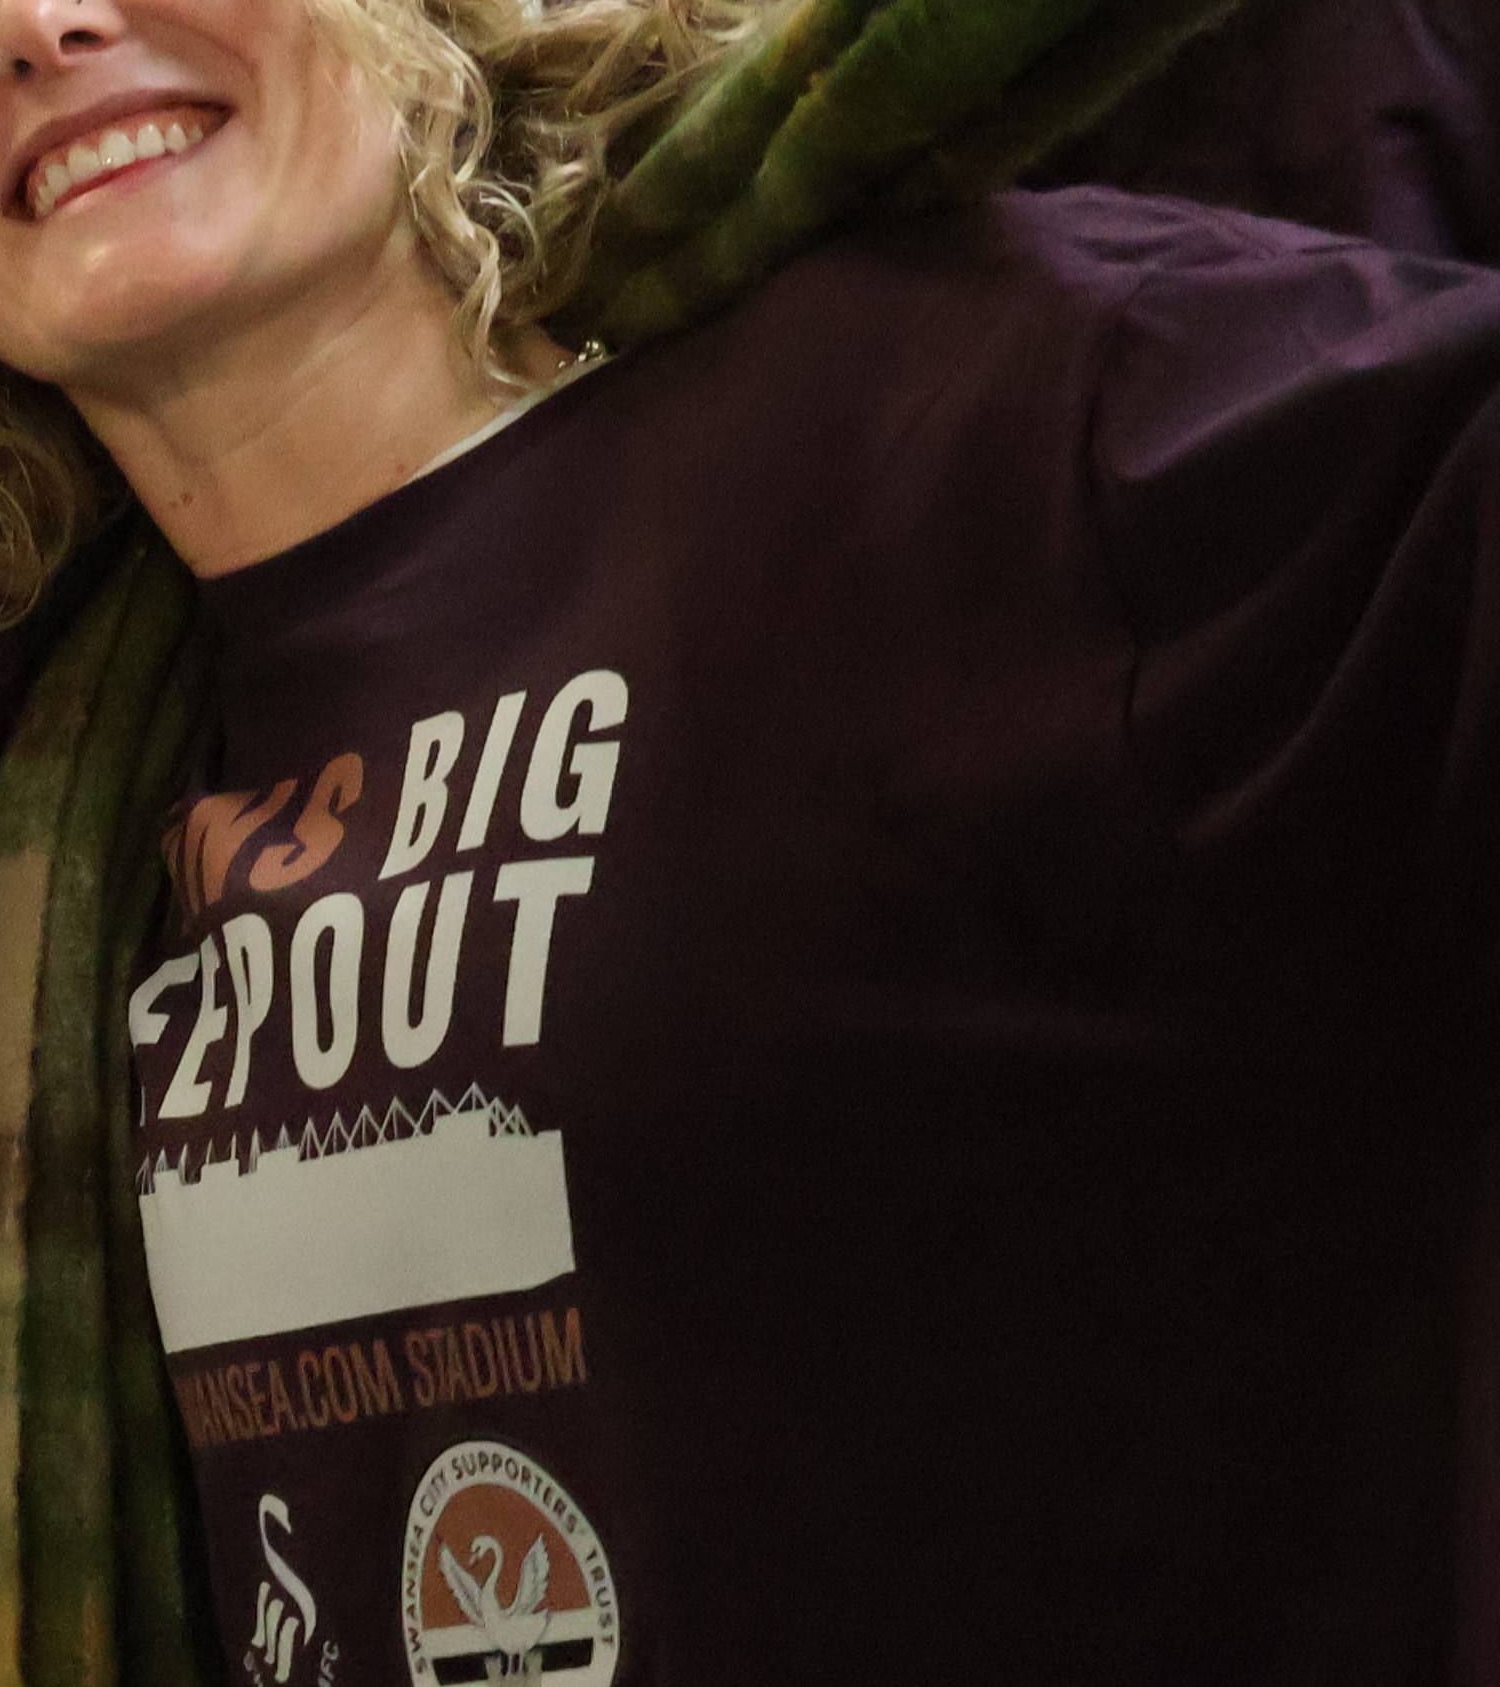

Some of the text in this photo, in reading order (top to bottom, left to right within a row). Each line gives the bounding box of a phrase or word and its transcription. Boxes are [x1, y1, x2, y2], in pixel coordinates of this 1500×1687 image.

[378, 669, 628, 880] BIG
[404, 1307, 588, 1408] STADIUM
[404, 1525, 427, 1677] SWANSEA
[586, 1548, 614, 1645] TRUST
